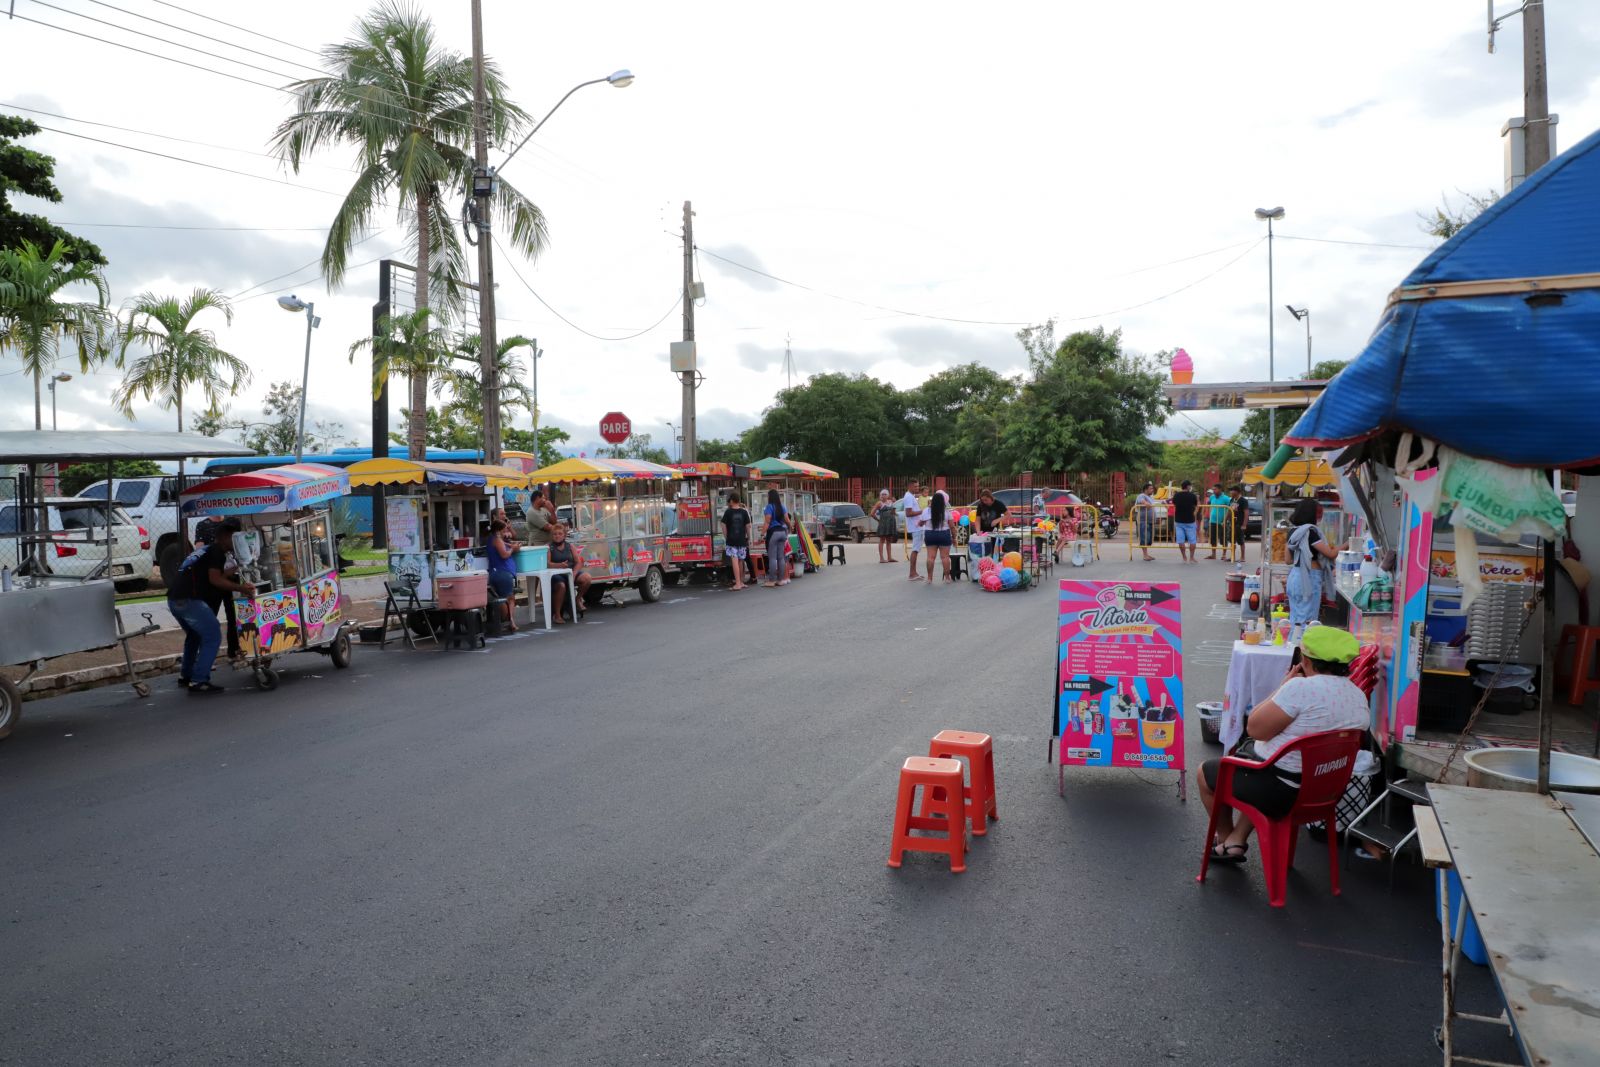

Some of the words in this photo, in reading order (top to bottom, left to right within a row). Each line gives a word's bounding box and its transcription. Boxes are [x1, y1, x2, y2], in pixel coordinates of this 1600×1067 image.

[602, 422, 628, 434] PARE
[298, 484, 318, 500] CHURROS
[196, 497, 233, 509] CHURROS
[234, 494, 280, 508] QUENTINHO
[1465, 513, 1488, 529] FAÇA
[1073, 682, 1091, 690] FRENTE
[1314, 756, 1348, 777] ITAIPAVA
